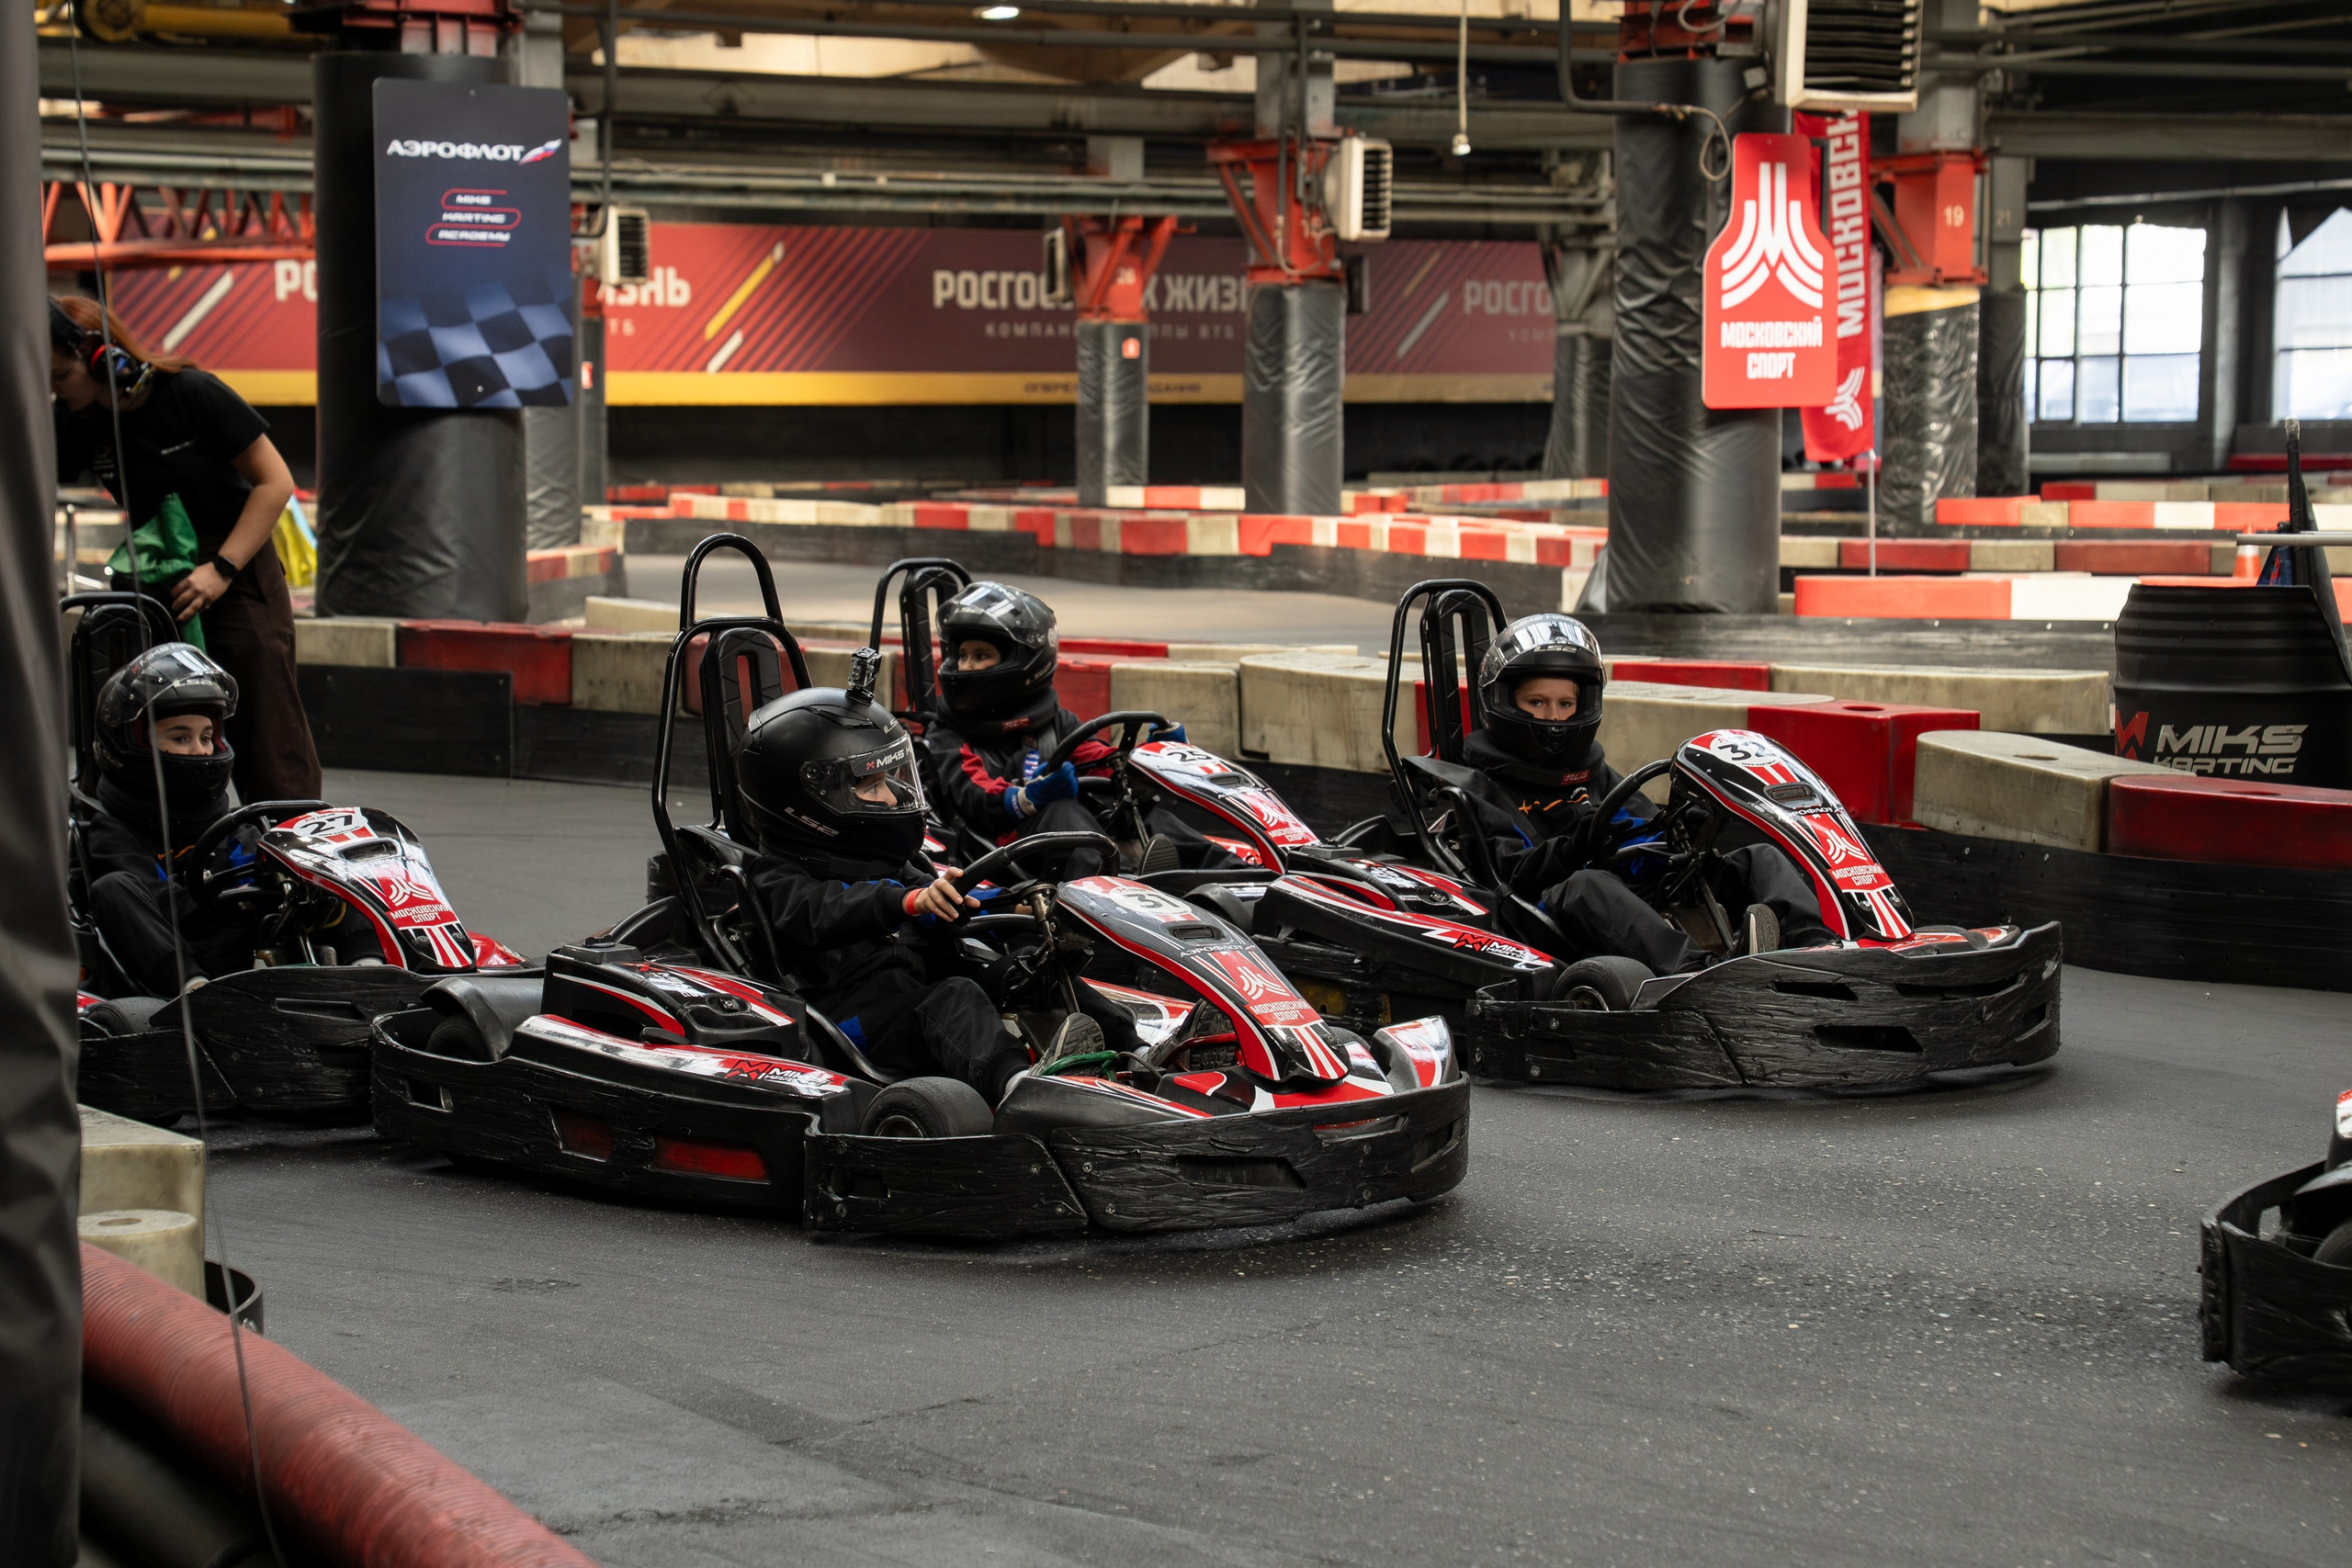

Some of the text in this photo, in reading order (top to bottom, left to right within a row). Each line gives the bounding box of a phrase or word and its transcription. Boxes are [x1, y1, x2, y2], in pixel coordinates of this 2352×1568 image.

[387, 140, 525, 162] АЭРОФЛОТ
[1826, 108, 1865, 339] МОСКОВСК
[1943, 205, 1964, 228] 19
[1721, 315, 1823, 348] МОСКОВСКИЙ
[1747, 352, 1796, 379] СПОРТ
[1533, 645, 1577, 654] LS2
[883, 718, 899, 734] LS
[2155, 724, 2309, 754] MIKS
[876, 749, 905, 768] MIKS
[1167, 750, 1213, 762] 25
[1717, 741, 1777, 761] 32
[300, 815, 353, 835] 27
[784, 807, 840, 837] LS2
[1831, 863, 1885, 880] МОСКОВСКИЙ
[1851, 874, 1878, 886] СПОРТ
[1122, 894, 1182, 908] 31
[390, 903, 453, 920] МОСКОВСКИЙ
[411, 912, 442, 923] СПОРТ
[1181, 945, 1244, 958] АЭРОФЛОТ
[1249, 998, 1313, 1016] МОСКОВСКИЙ
[1273, 1010, 1305, 1022] СПОРТ
